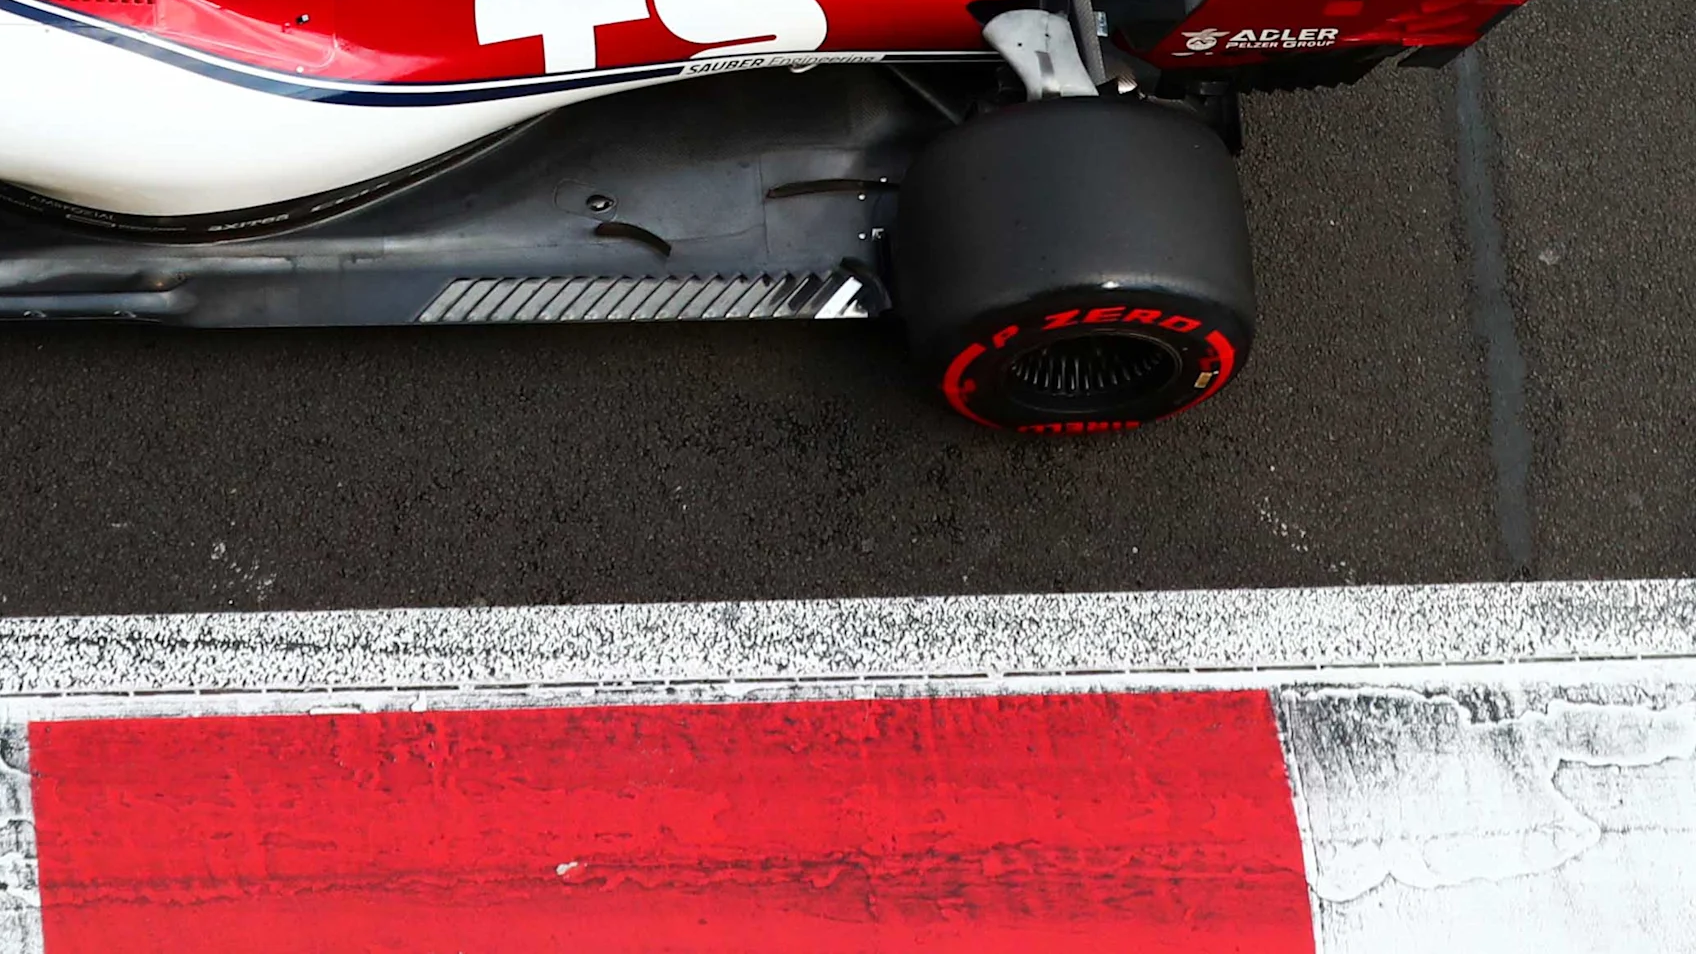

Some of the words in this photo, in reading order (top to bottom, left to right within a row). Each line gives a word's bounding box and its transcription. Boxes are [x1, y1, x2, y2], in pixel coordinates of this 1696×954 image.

[1229, 28, 1339, 42] ADLER
[686, 57, 765, 75] SAUBER
[767, 55, 875, 68] Engineering
[992, 324, 1019, 349] P
[1042, 306, 1202, 334] ZERO
